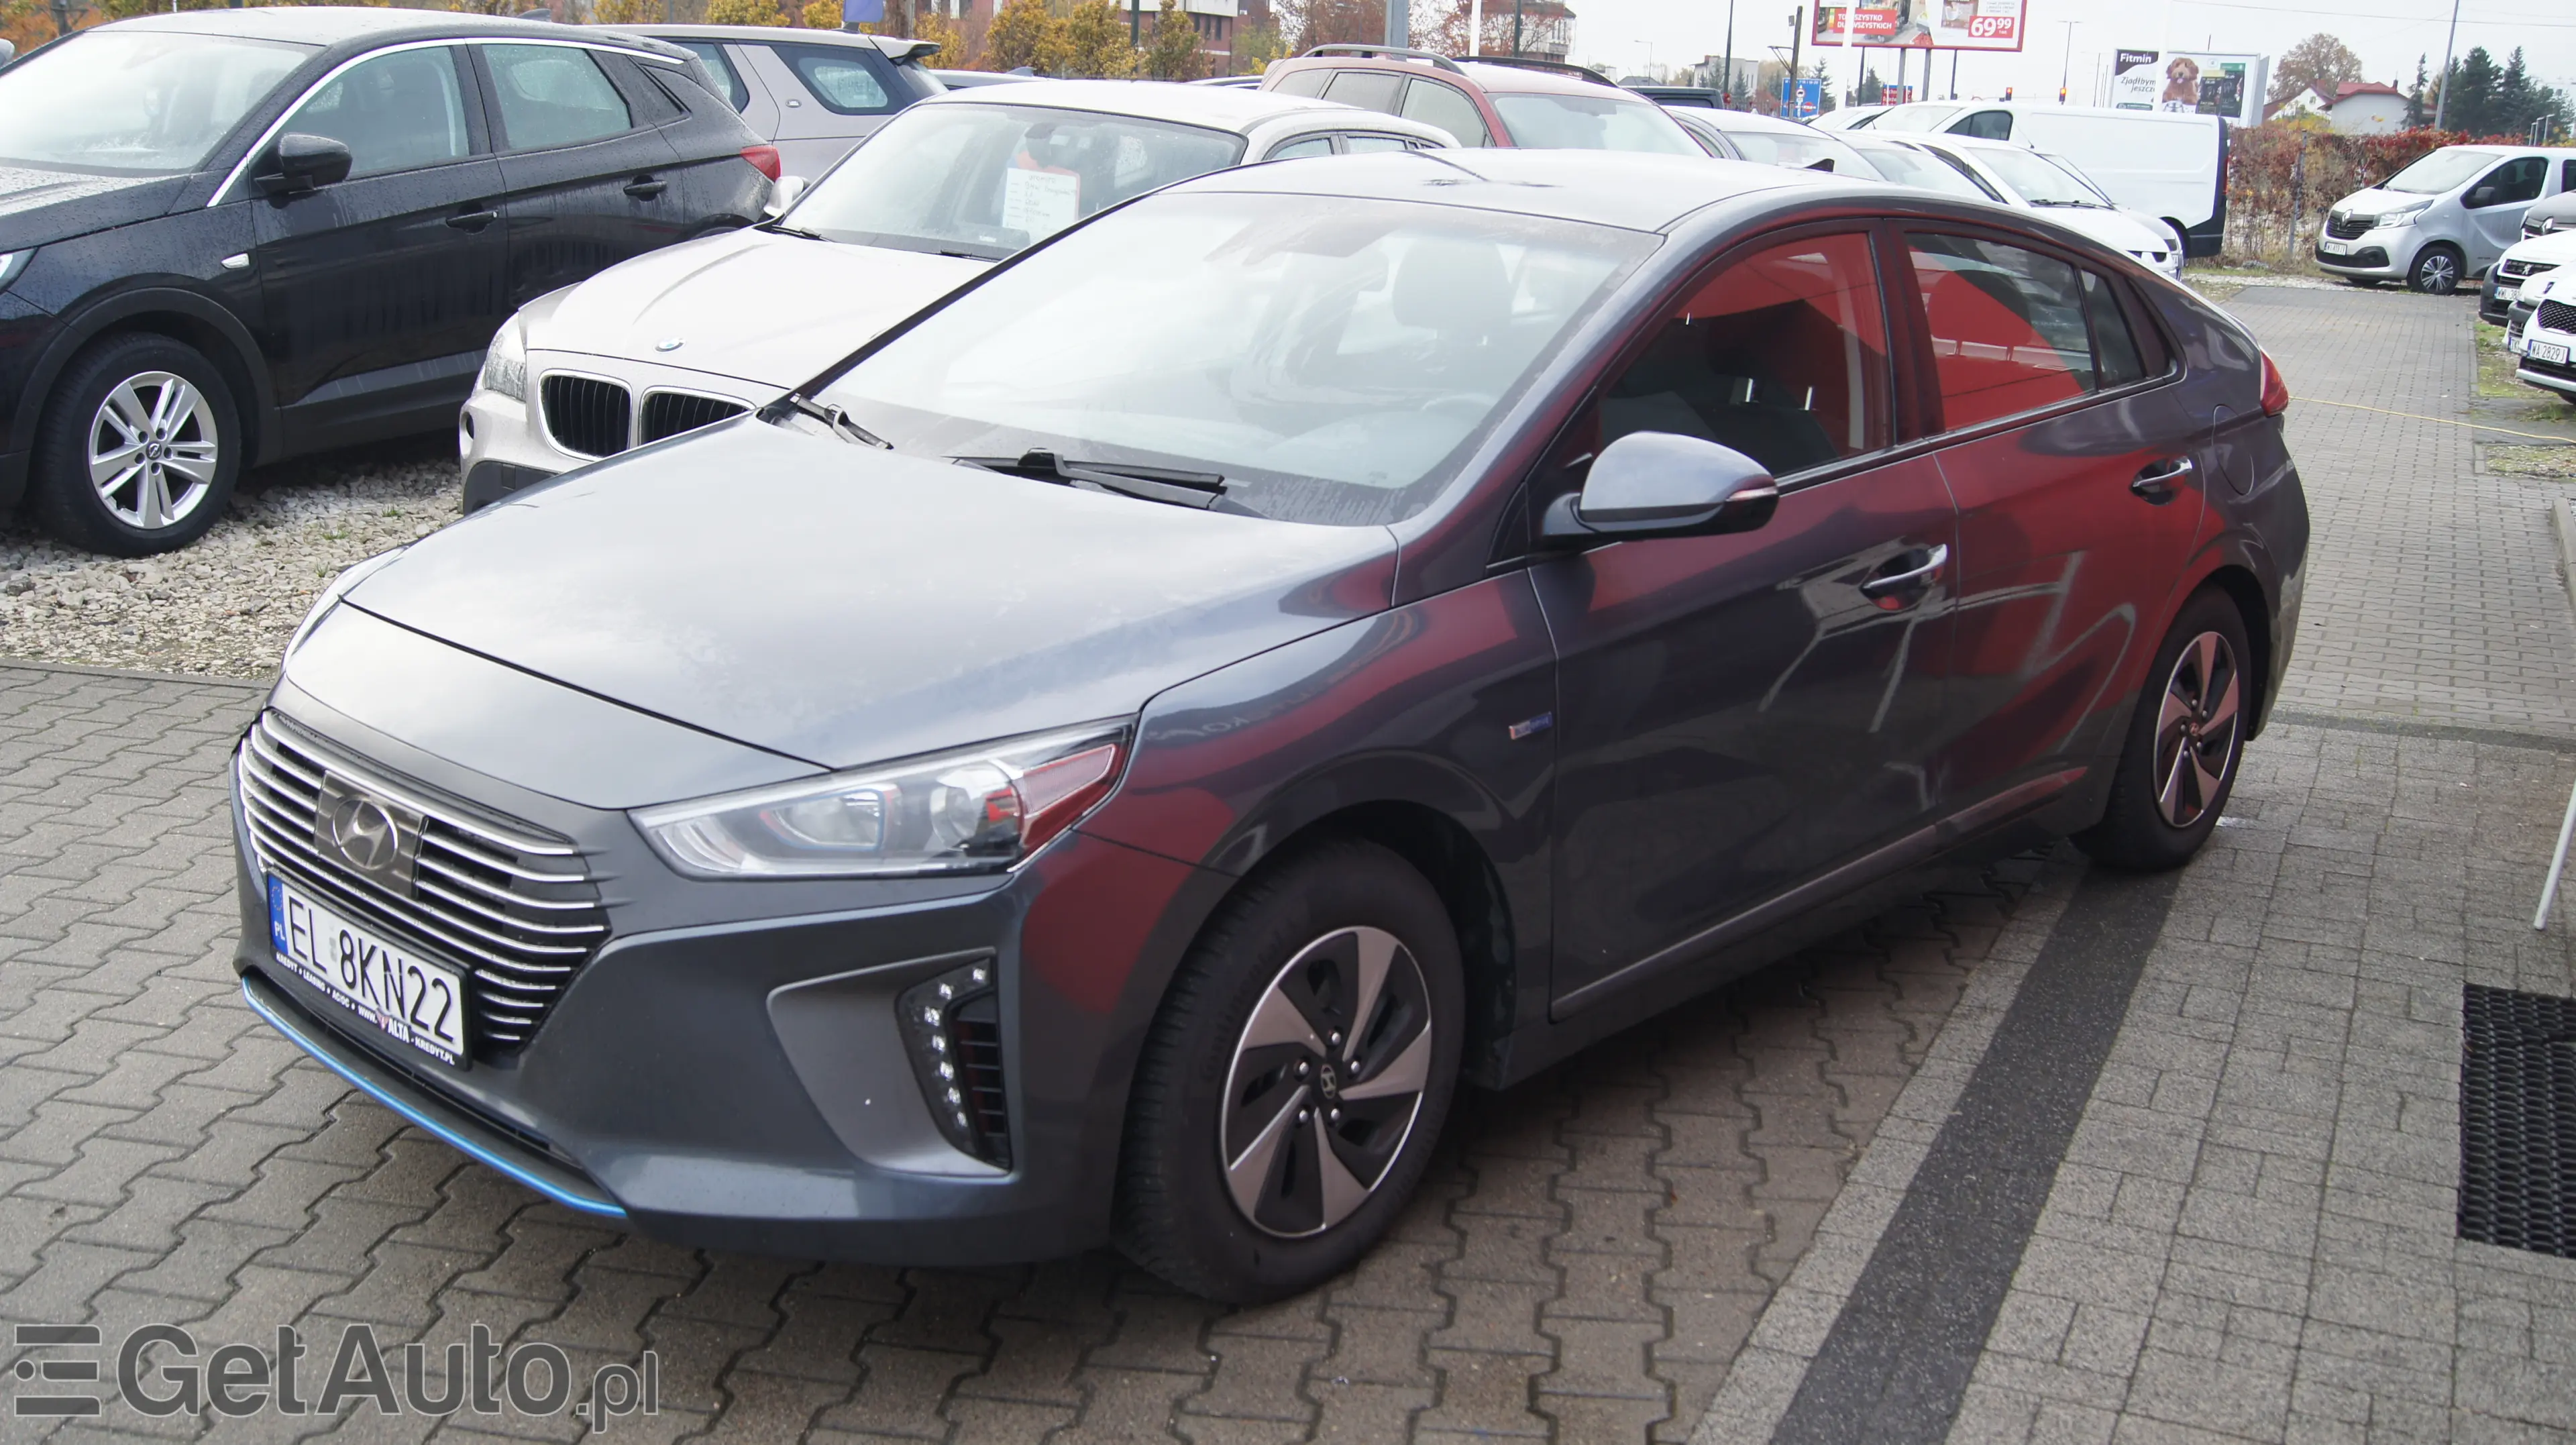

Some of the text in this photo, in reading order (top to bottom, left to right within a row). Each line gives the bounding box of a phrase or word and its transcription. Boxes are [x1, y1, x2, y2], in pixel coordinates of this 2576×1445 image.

[1854, 13, 1883, 21] SZYSTKO
[1970, 17, 2012, 37] 69 99
[2120, 52, 2152, 63] Fitmin
[2532, 343, 2540, 357] WA
[274, 920, 286, 941] PL
[288, 894, 455, 1043] EL 8KN22
